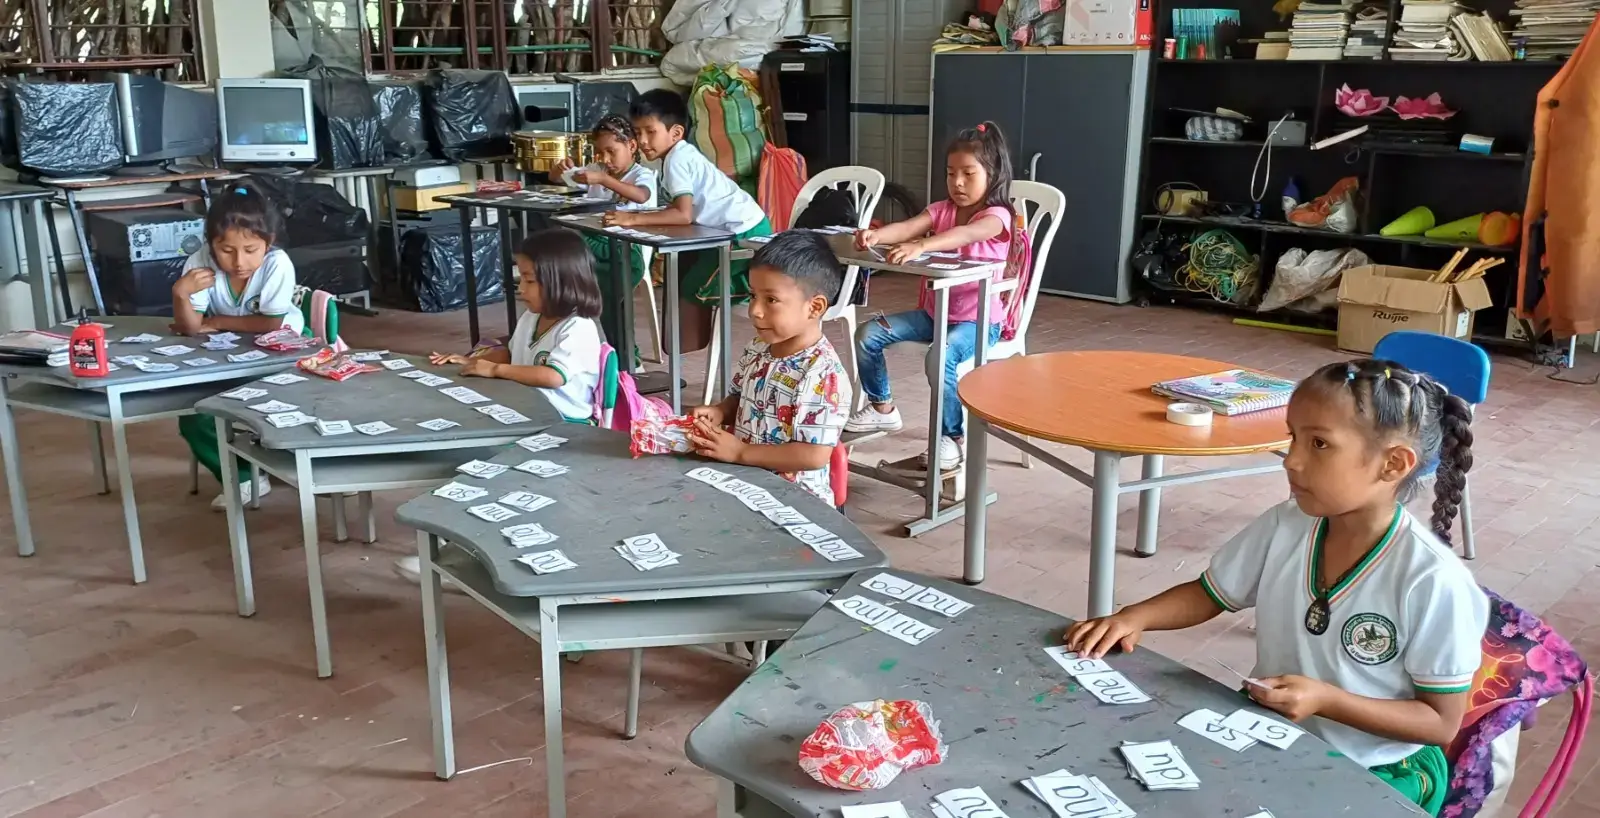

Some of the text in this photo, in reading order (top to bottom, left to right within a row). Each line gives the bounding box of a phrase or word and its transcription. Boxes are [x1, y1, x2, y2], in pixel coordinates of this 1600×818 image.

[1372, 310, 1409, 323] Ruijie
[448, 487, 475, 499] se
[516, 494, 540, 506] la
[869, 580, 968, 616] ma pa
[842, 599, 935, 641] mi mo
[1092, 678, 1139, 702] me
[1145, 752, 1185, 780] du
